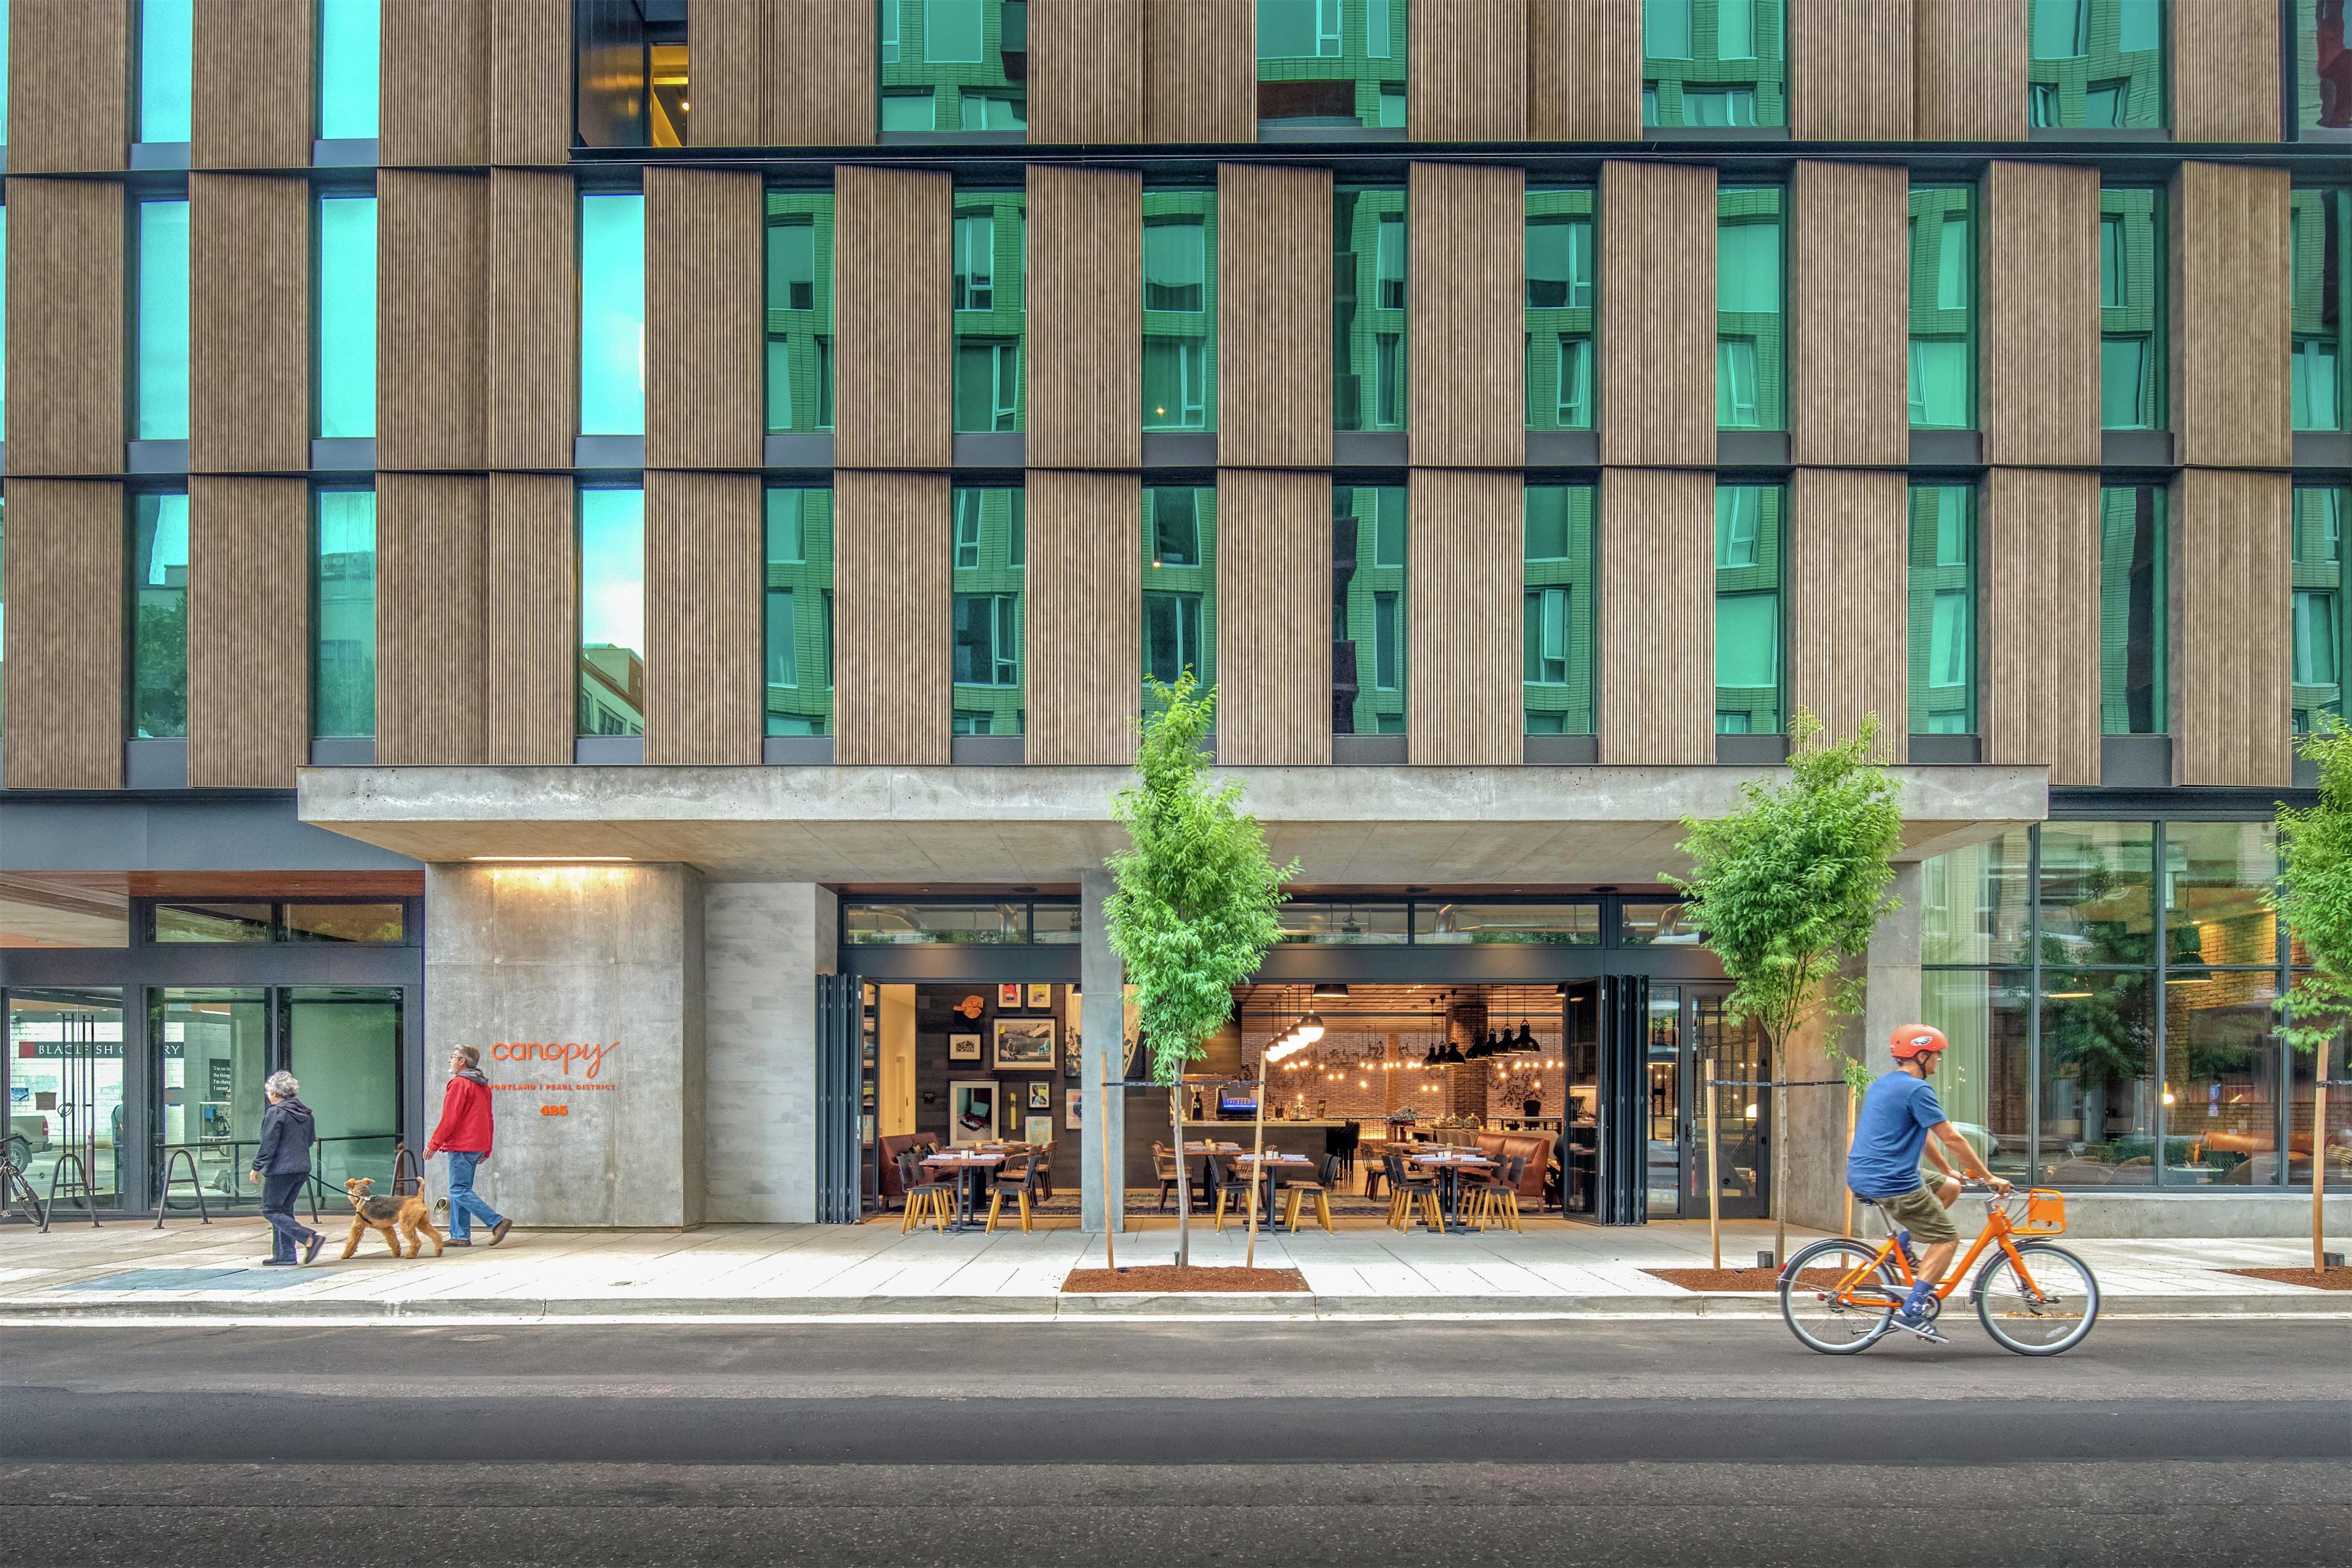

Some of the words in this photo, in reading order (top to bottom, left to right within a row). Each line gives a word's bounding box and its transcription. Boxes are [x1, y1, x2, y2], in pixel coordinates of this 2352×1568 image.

[39, 1045, 113, 1055] BLACFSH
[491, 1040, 620, 1079] canopy
[540, 1104, 568, 1116] 425
